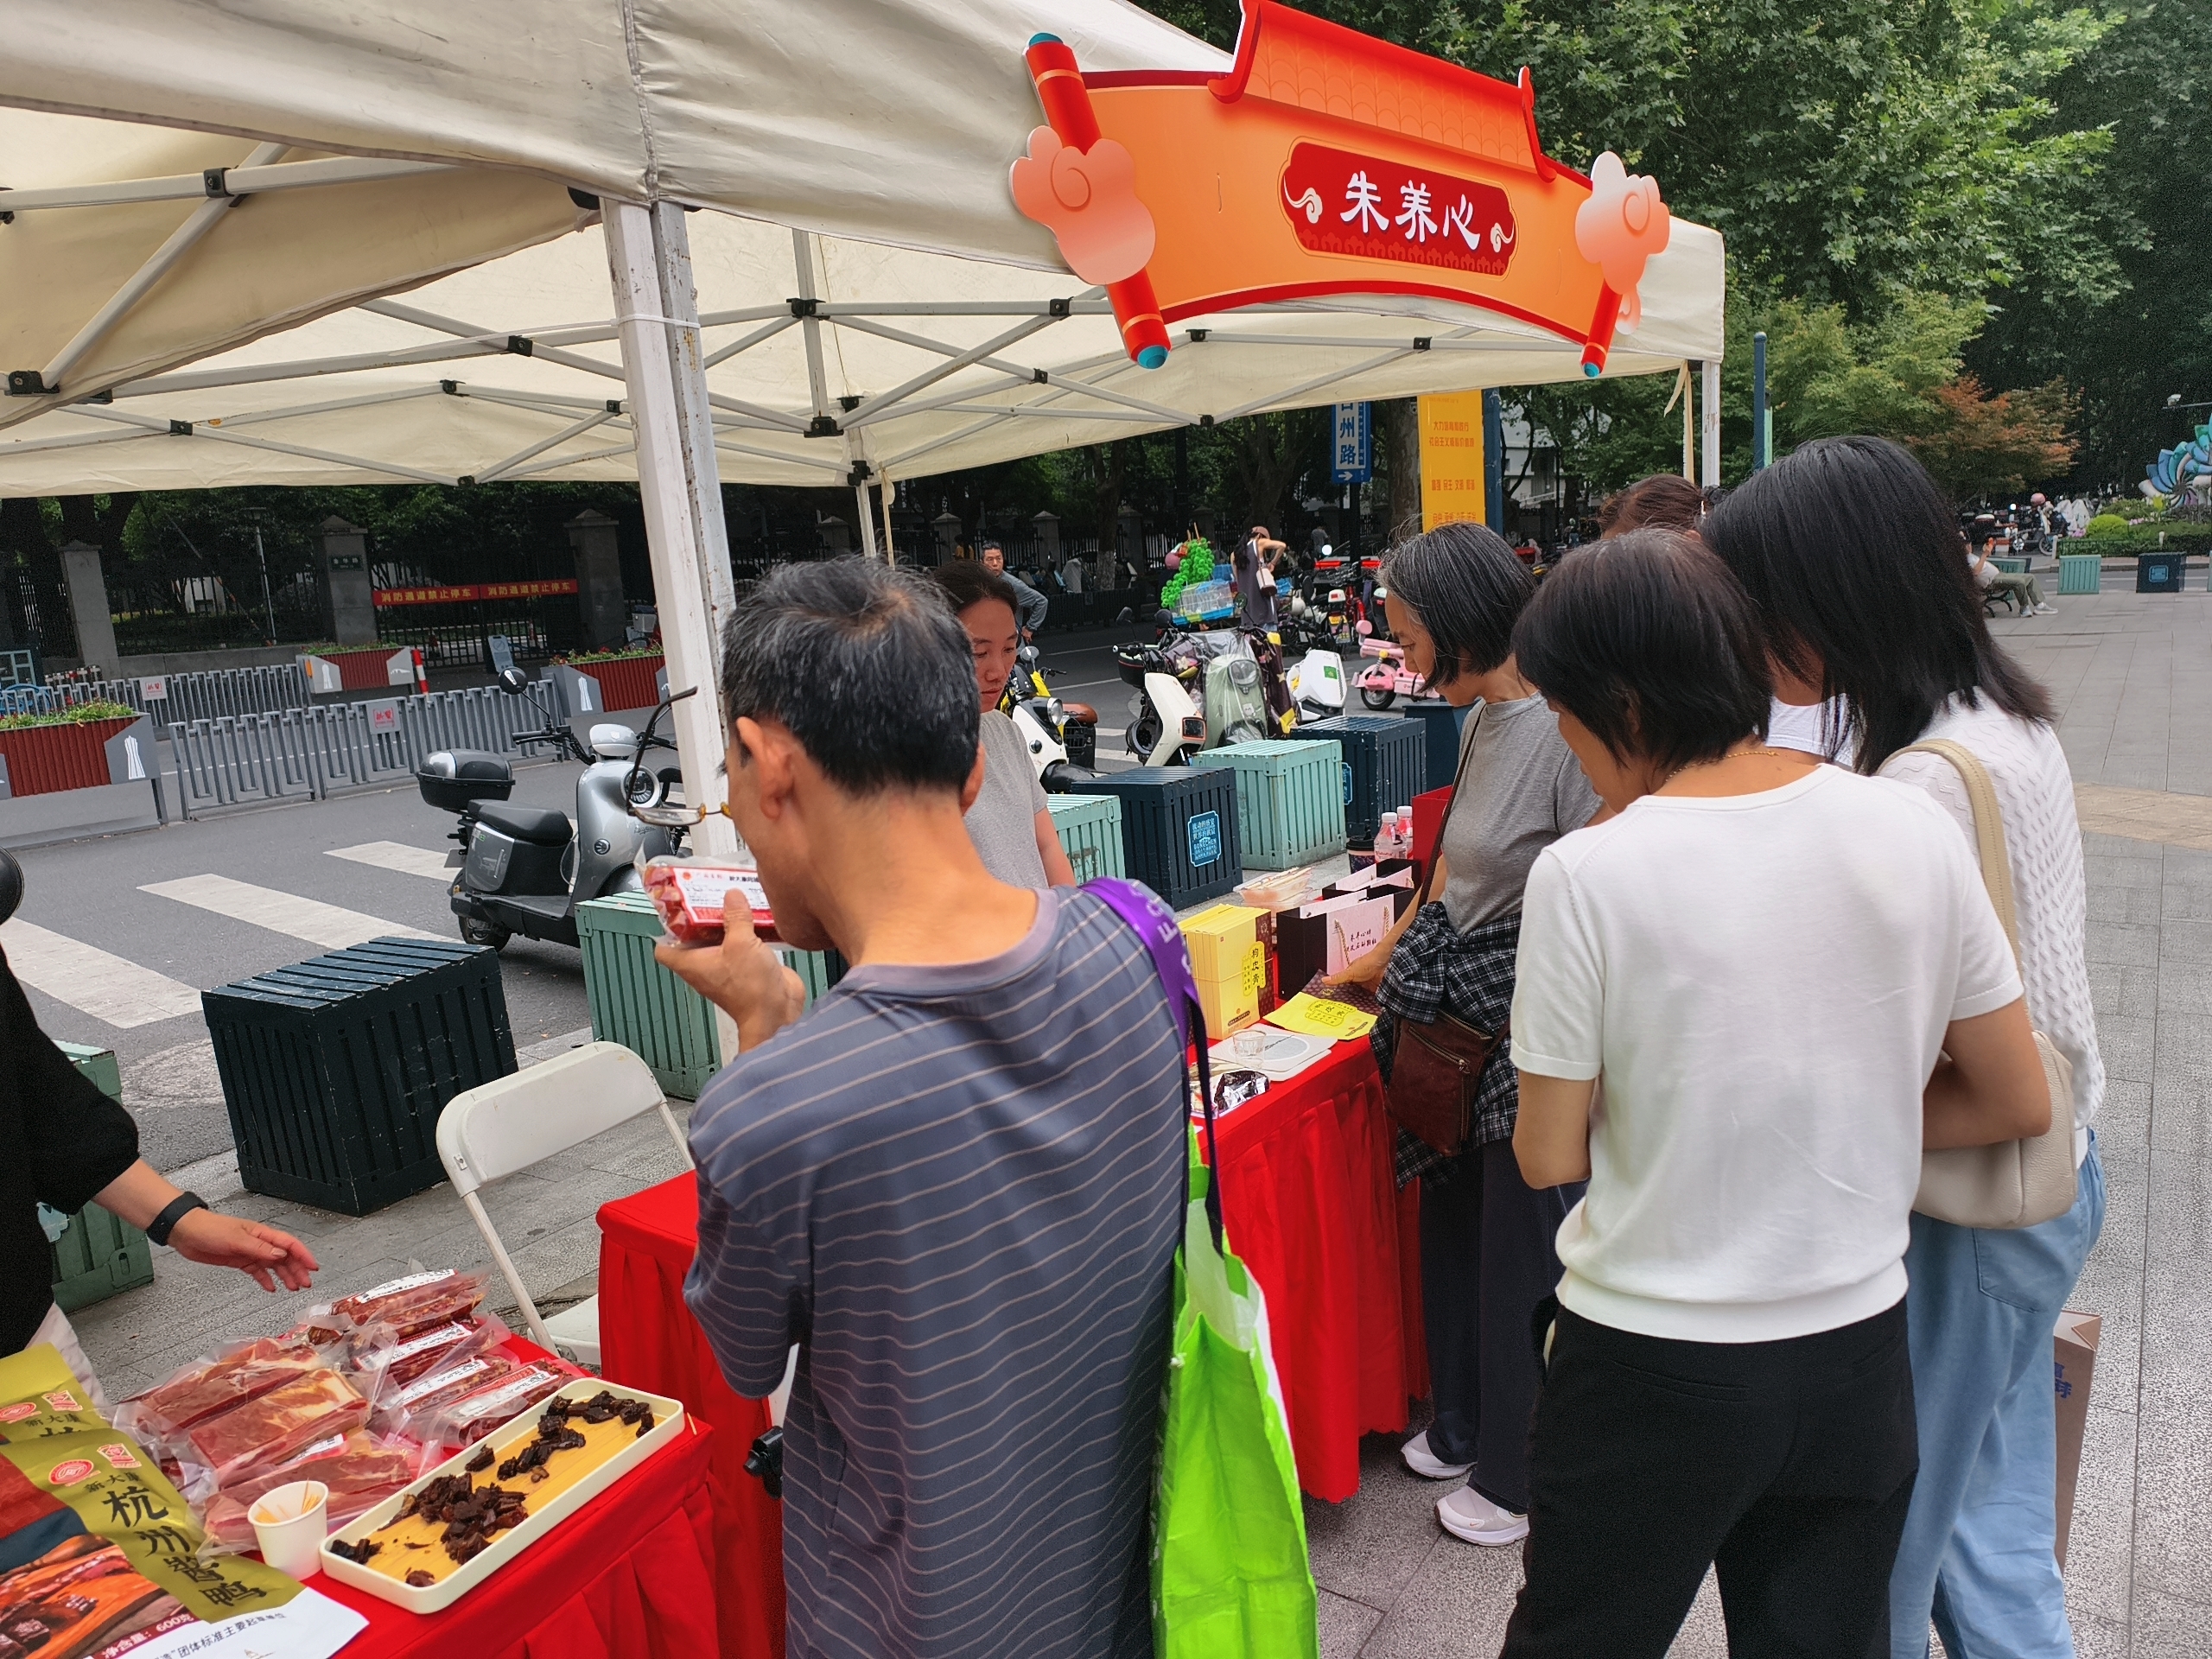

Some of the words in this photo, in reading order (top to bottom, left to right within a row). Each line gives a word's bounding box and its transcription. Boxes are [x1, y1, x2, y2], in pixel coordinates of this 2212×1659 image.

[1339, 170, 1481, 251] 朱养心
[381, 588, 472, 602] 消防通道禁止停车
[487, 582, 571, 596] 消防通道禁止停车
